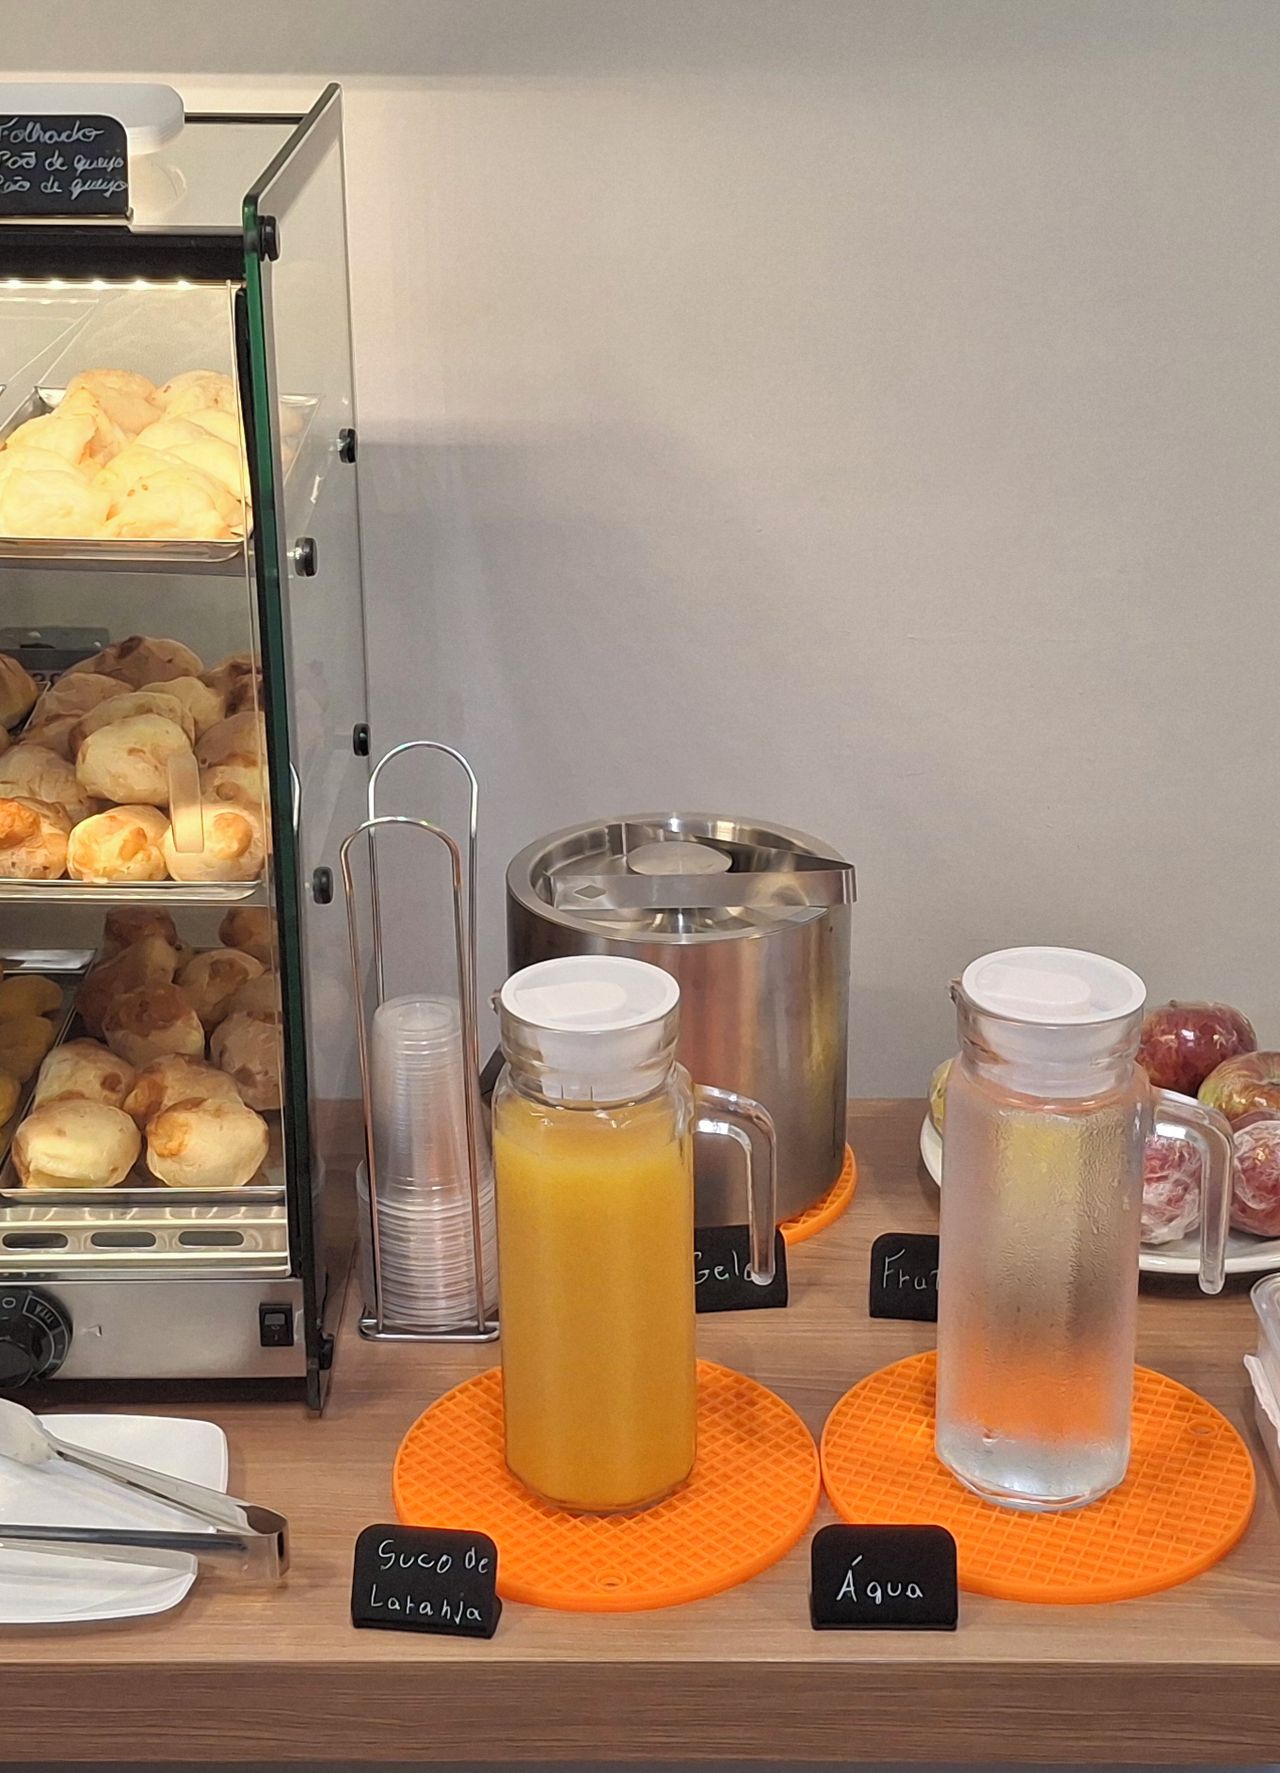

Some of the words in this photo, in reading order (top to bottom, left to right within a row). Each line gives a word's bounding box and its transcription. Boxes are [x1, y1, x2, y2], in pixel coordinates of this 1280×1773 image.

[44, 148, 69, 172] de
[39, 174, 64, 194] de
[378, 1538, 453, 1575] Suco
[835, 1554, 925, 1605] Água
